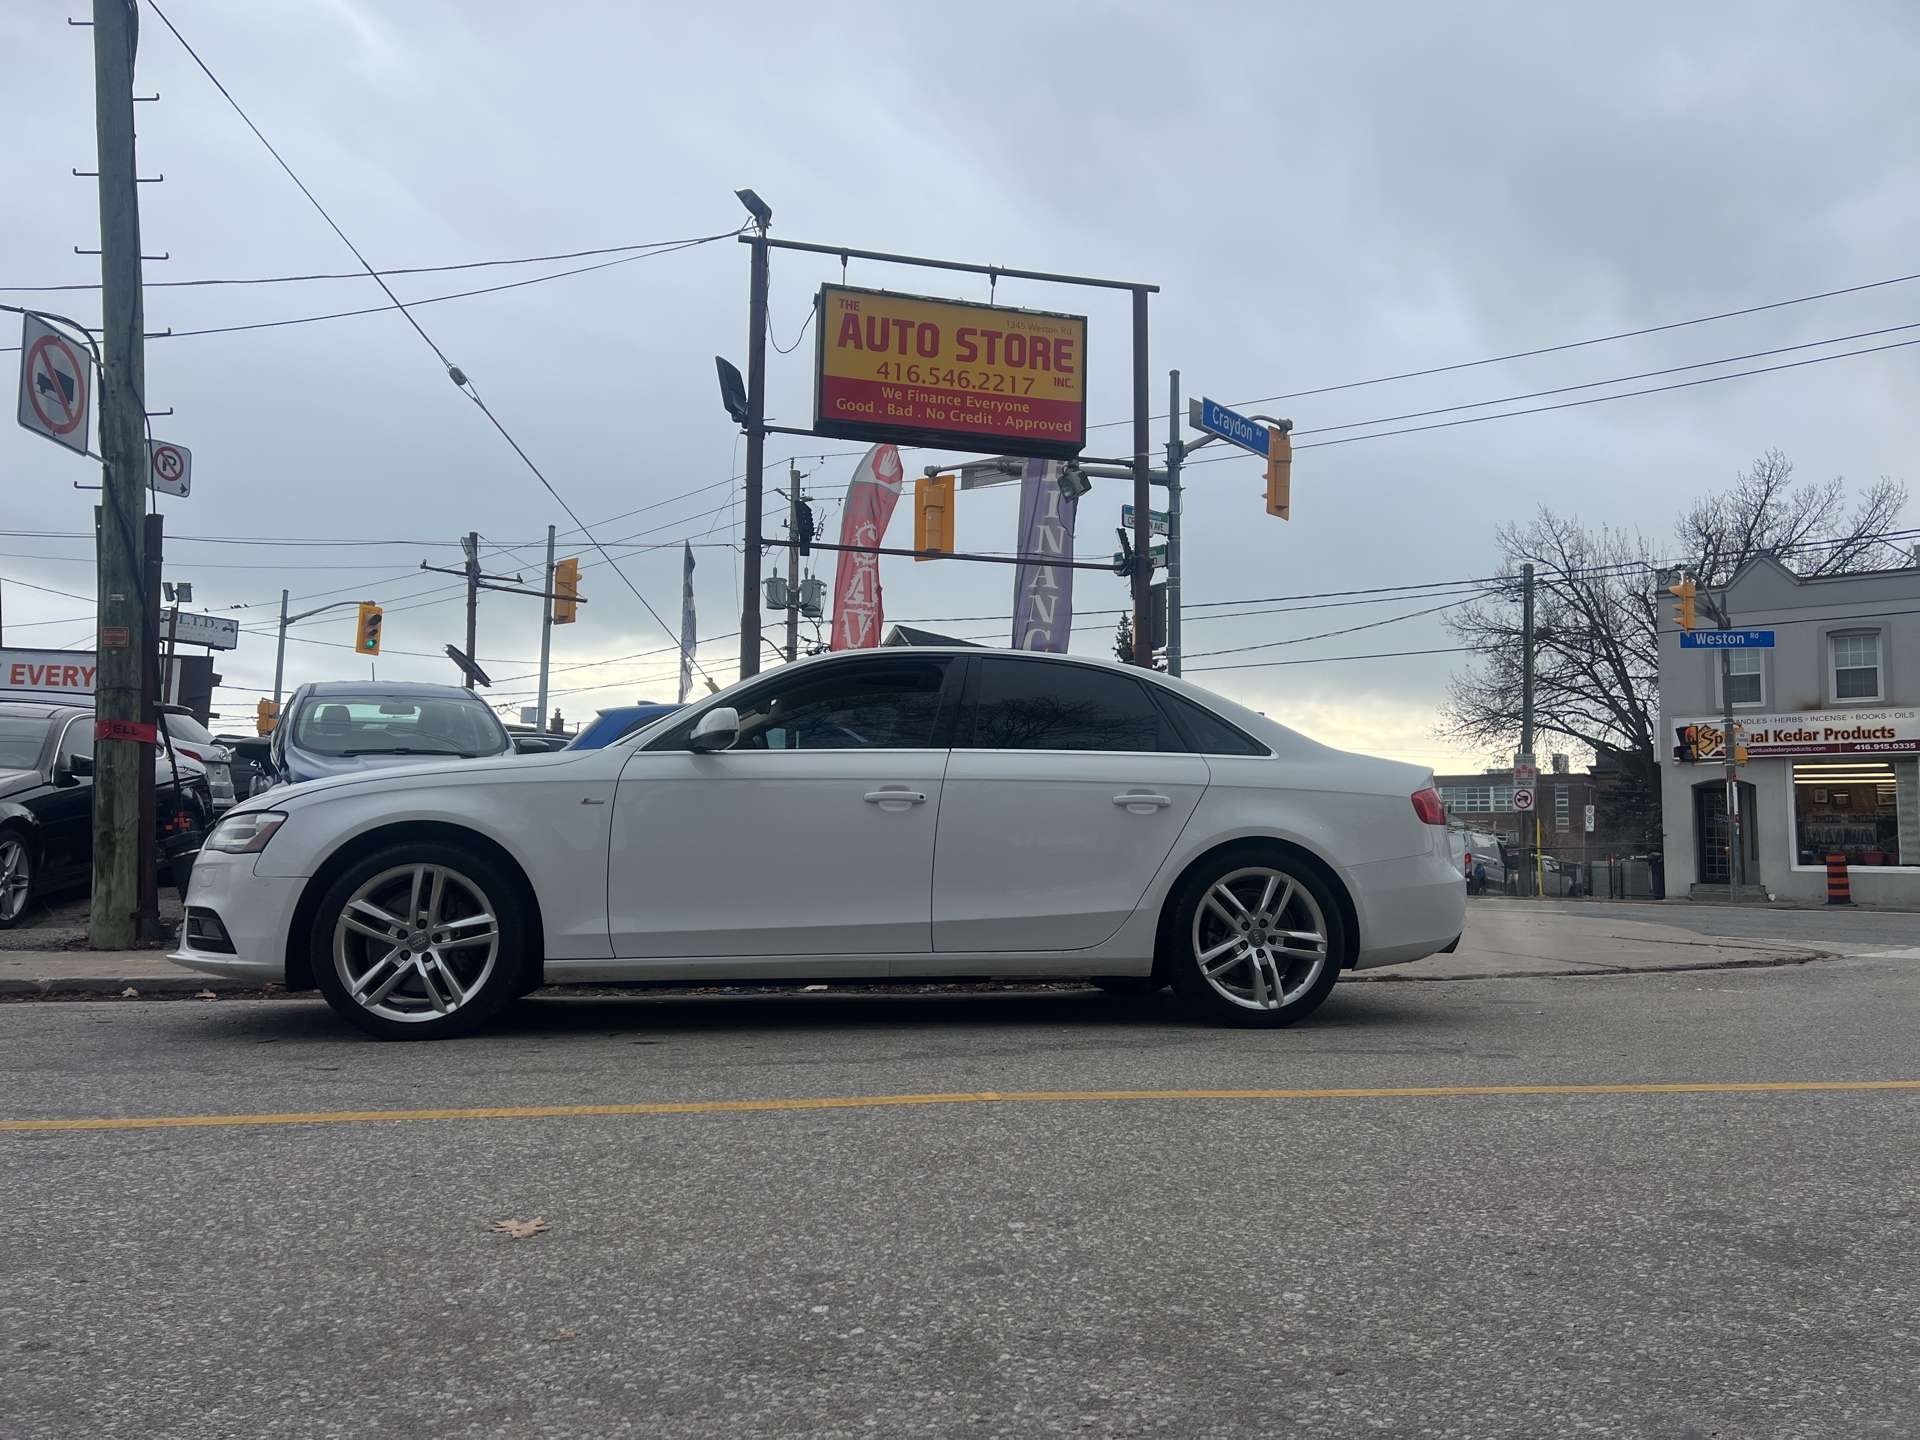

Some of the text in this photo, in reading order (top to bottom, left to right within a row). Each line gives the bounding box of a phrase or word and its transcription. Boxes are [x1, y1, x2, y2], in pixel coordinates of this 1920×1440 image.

[839, 298, 860, 312] THE
[837, 313, 1075, 374] AUTO STORE
[876, 361, 1036, 395] 416.546.2217
[1053, 376, 1075, 389] INC.
[882, 386, 1031, 414] We Finance Everyone
[836, 398, 1073, 436] Good Bad No Credit Approved
[1212, 406, 1253, 441] Craydon
[1695, 632, 1759, 645] Weston Rd
[10, 663, 97, 687] EVERY
[1774, 715, 1803, 724] HERBS
[1810, 714, 1847, 722] INCENSE
[1855, 712, 1887, 721] BOOKS
[1894, 711, 1915, 719] OILS
[1773, 728, 1820, 743] Kedar
[1824, 726, 1896, 741] Products
[1854, 742, 1917, 751] 416.915.0335
